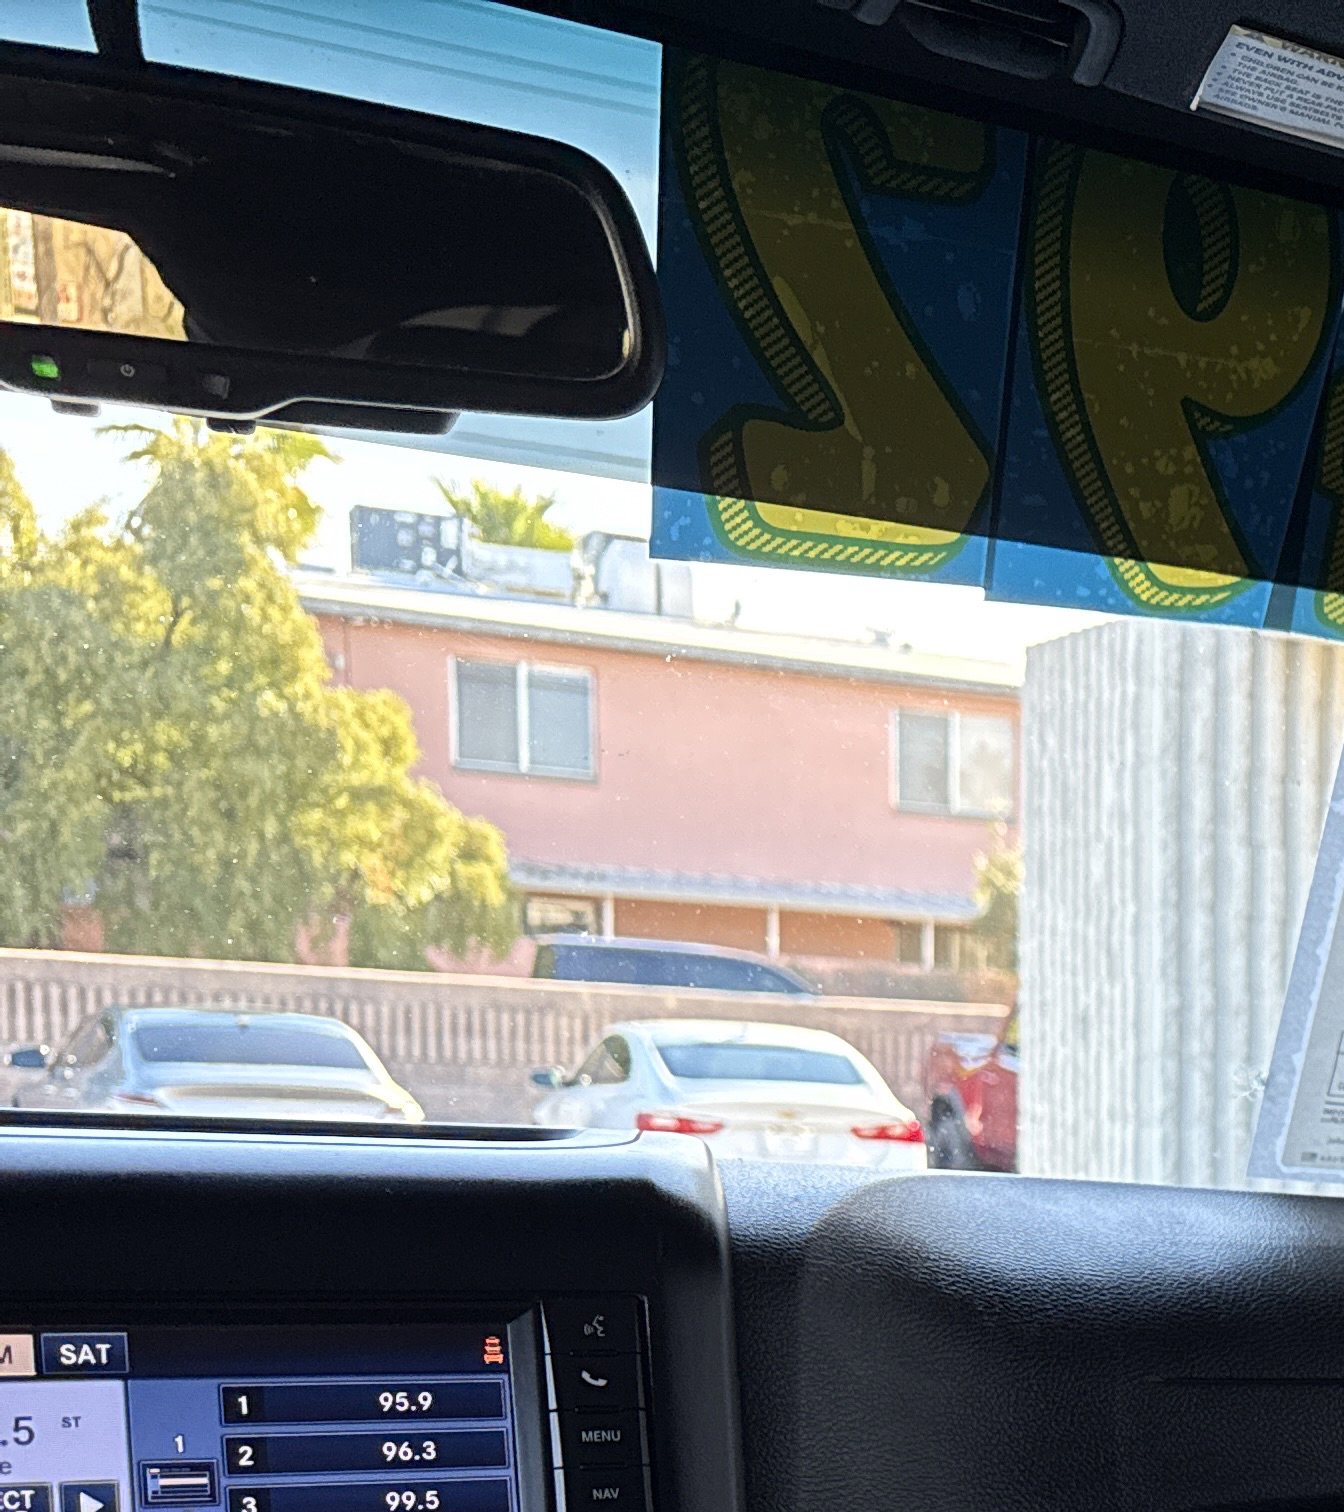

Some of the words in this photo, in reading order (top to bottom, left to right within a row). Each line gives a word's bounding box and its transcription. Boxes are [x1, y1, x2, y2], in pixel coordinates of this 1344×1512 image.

[1235, 40, 1273, 59] EVEN
[1277, 54, 1313, 72] WITH
[59, 1343, 112, 1365] SAT
[237, 1395, 248, 1415] 1
[378, 1391, 432, 1411] 95.9
[61, 1416, 81, 1428] ST
[174, 1434, 184, 1453] 1
[581, 1430, 621, 1442] MENU
[238, 1445, 254, 1466] 2
[382, 1441, 436, 1460] 96.3
[385, 1490, 439, 1510] 99.5
[592, 1488, 620, 1499] NAV
